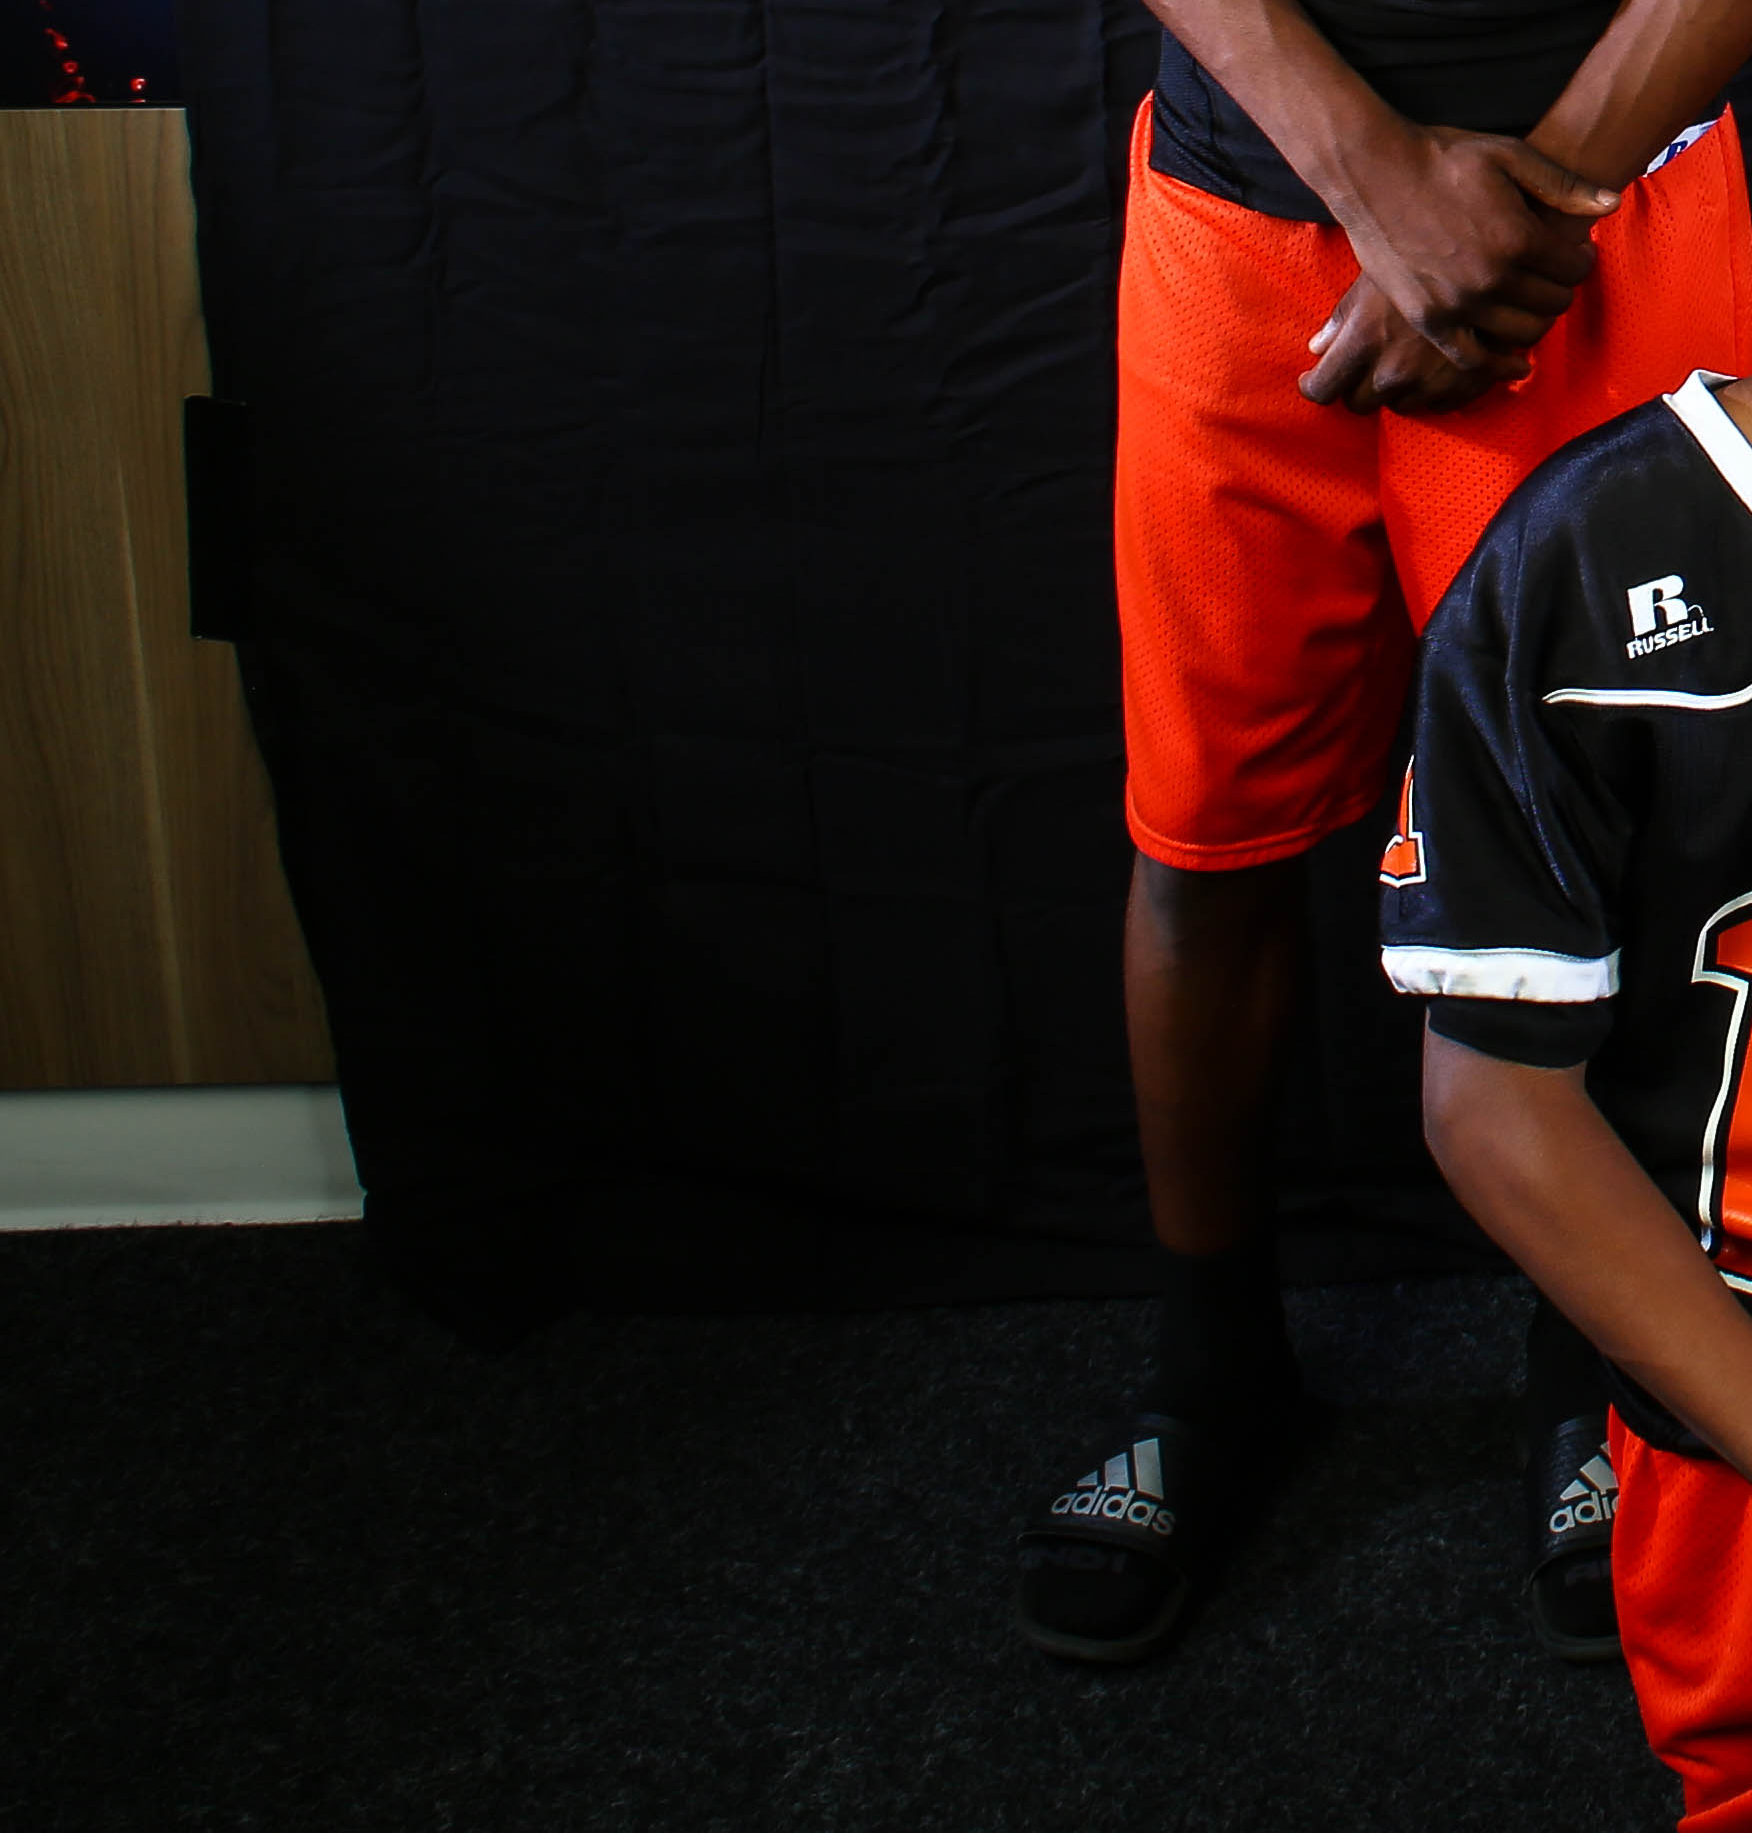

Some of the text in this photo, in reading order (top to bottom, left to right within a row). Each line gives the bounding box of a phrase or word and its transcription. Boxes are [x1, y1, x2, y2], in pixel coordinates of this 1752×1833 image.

[1626, 617, 1715, 659] RUSSELL
[1051, 1485, 1177, 1535] adidas
[1549, 1489, 1620, 1534] adi
